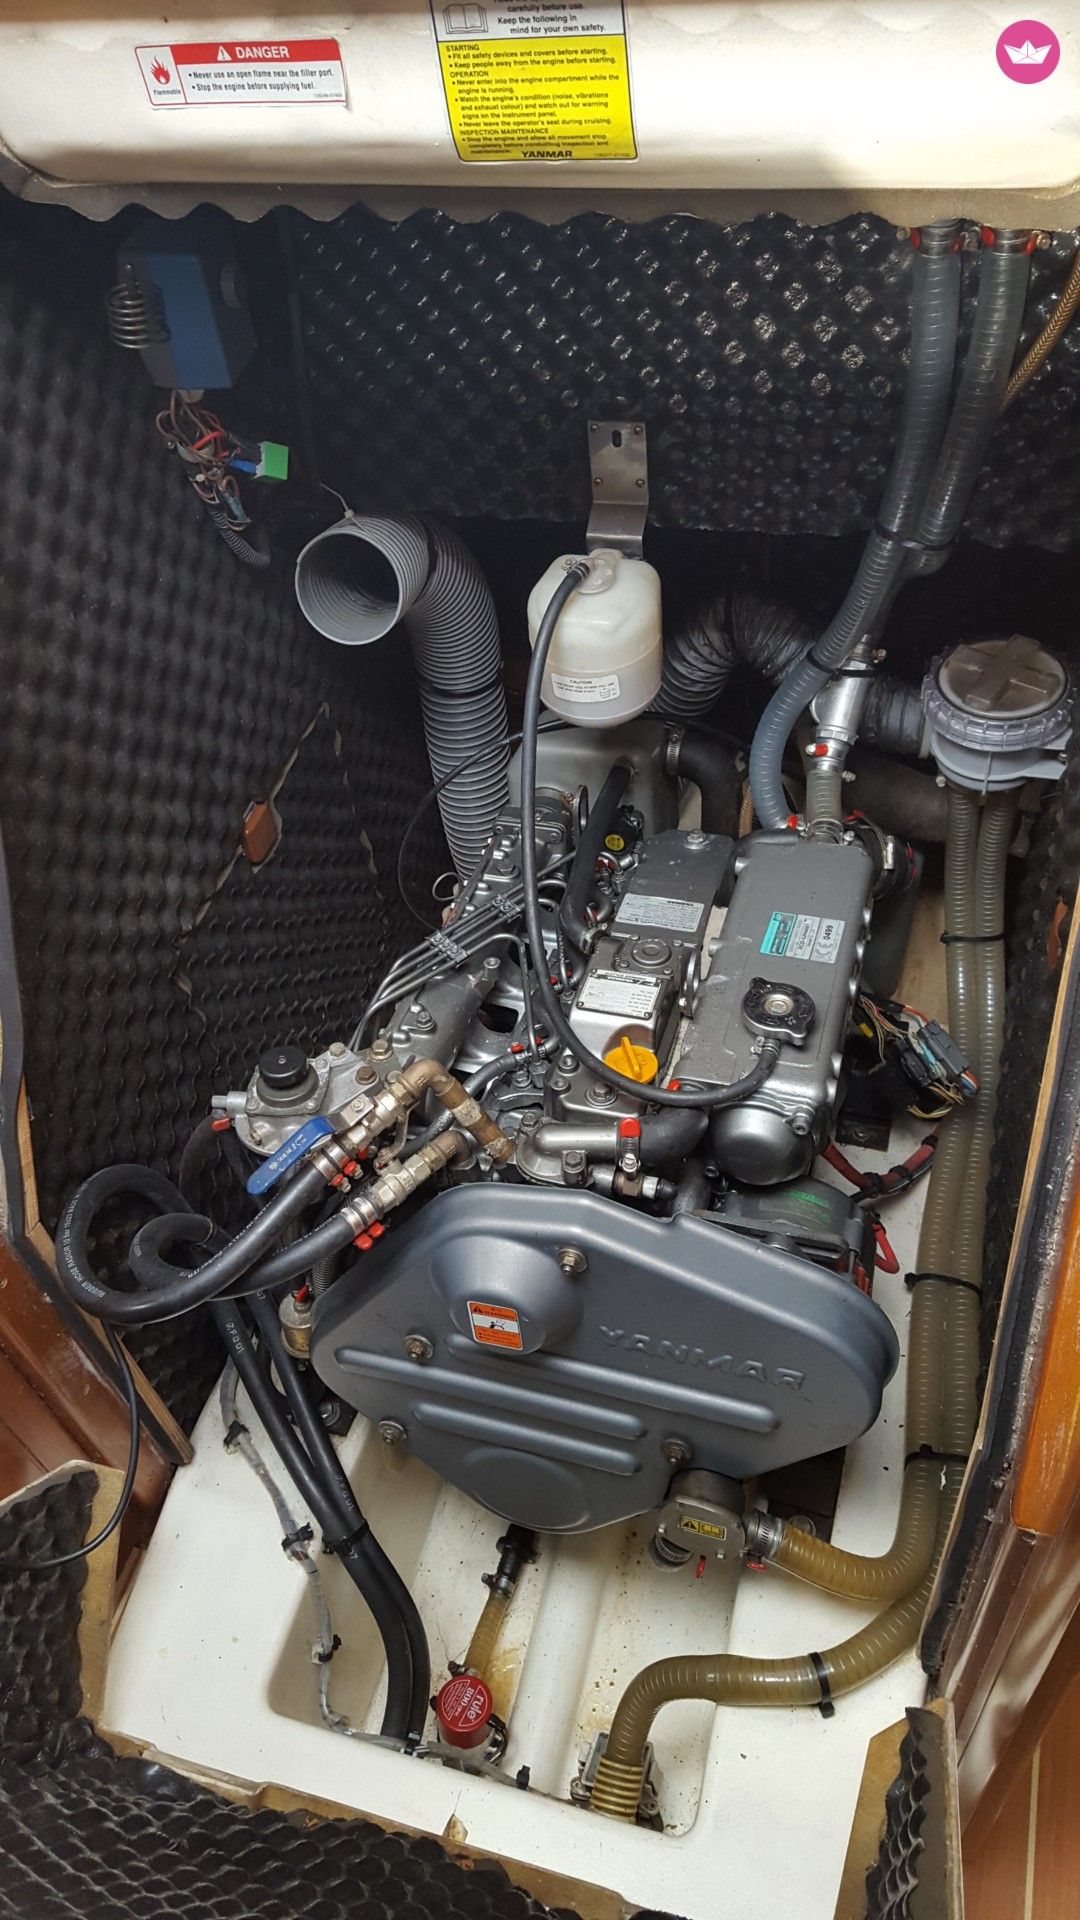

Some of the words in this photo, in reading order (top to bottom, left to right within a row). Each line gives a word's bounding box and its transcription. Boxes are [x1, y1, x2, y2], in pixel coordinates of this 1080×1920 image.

[507, 4, 539, 12] carefully
[498, 17, 516, 25] Keep
[519, 16, 531, 24] the
[533, 15, 567, 23] following
[581, 24, 606, 32] safety.
[236, 46, 290, 59] DANGER
[446, 44, 479, 52] STARTING
[472, 52, 491, 60] safety
[301, 69, 316, 77] filler
[318, 69, 334, 77] port.
[224, 83, 245, 91] engine
[270, 83, 299, 91] supplying
[70, 1266, 83, 1282] HOSE
[81, 1281, 106, 1298] RUBBER
[599, 1325, 806, 1390] YANMAR
[467, 1694, 485, 1719] rule
